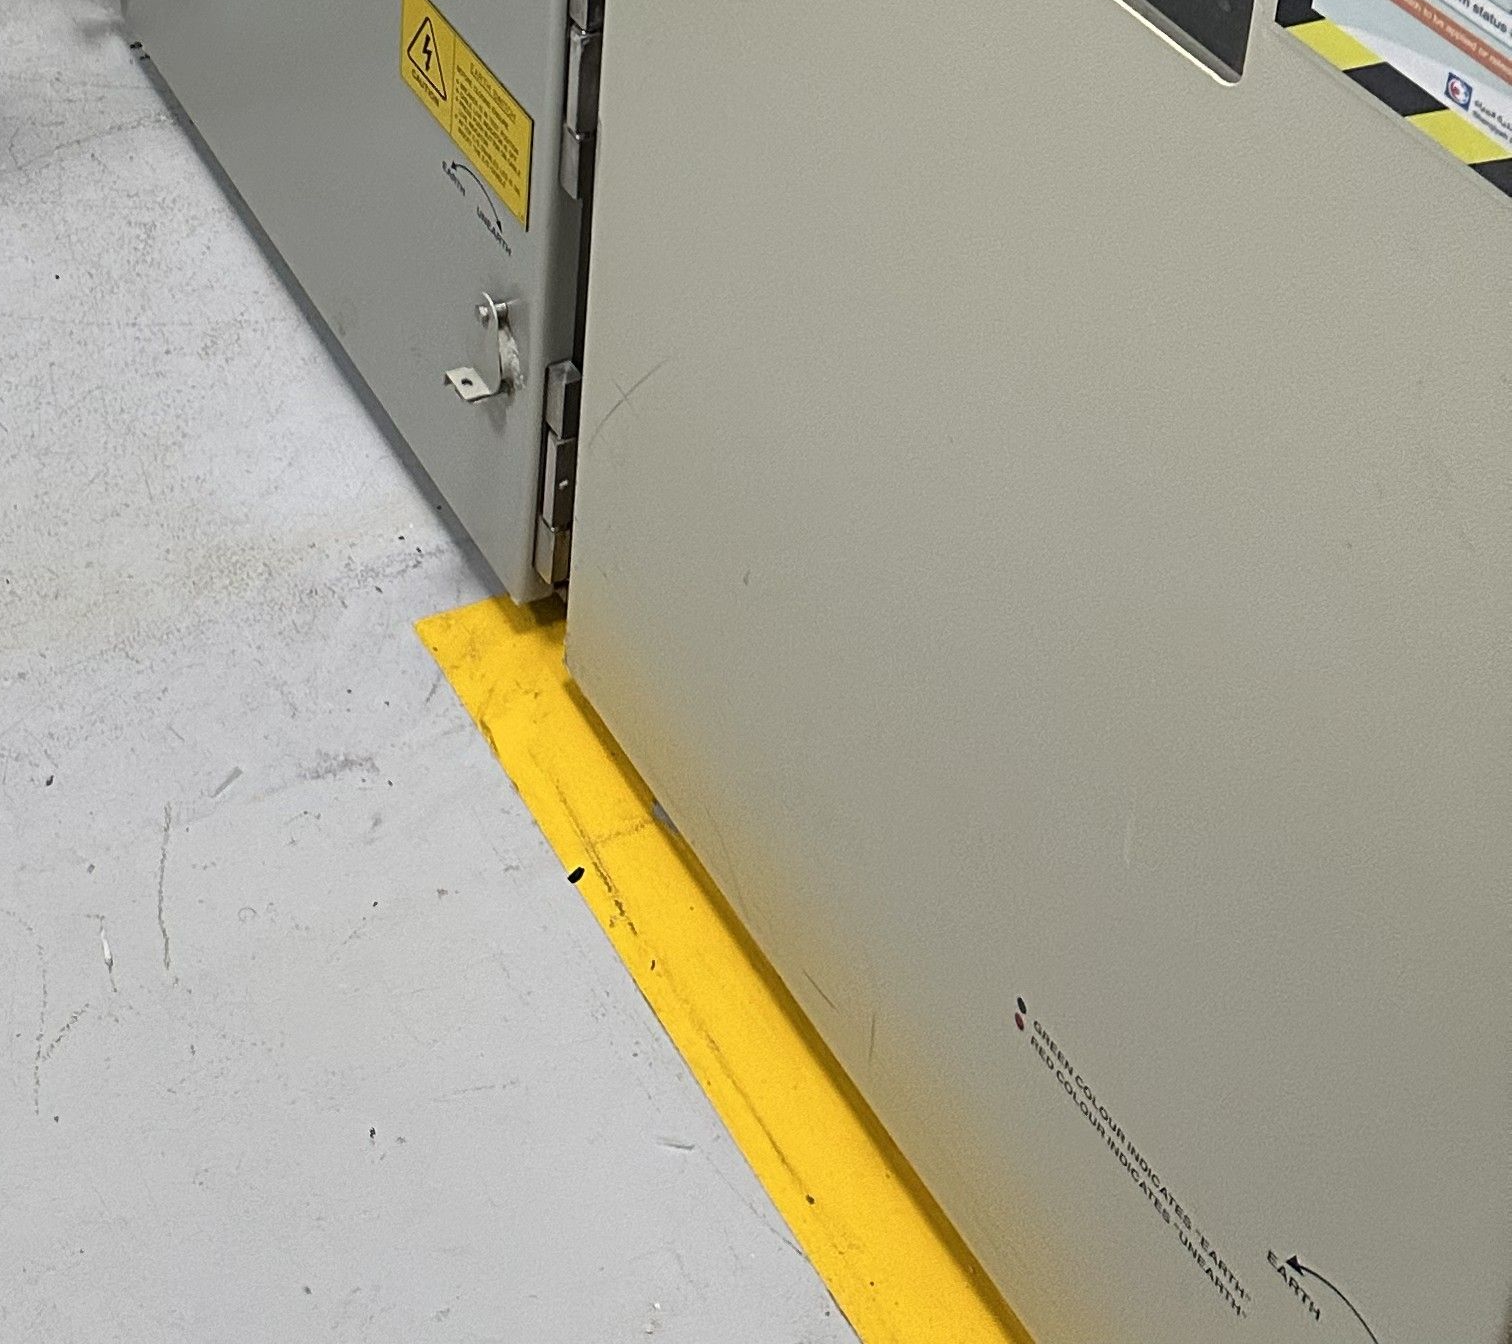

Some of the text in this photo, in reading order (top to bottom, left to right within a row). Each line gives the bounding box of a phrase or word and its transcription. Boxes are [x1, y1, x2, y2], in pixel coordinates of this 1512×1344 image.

[1472, 0, 1508, 34] status
[412, 68, 439, 107] CAUTION
[442, 160, 466, 197] EARTH
[477, 206, 512, 256] UNEARTH
[1030, 1035, 1054, 1071] RED
[1056, 1070, 1106, 1140] COLOUR
[1106, 1136, 1171, 1225] INDICATES
[1033, 1019, 1074, 1077] GREEN
[1075, 1075, 1126, 1143] COLOUR
[1127, 1142, 1193, 1231] INDICATES
[1266, 1250, 1321, 1322] EARTH
